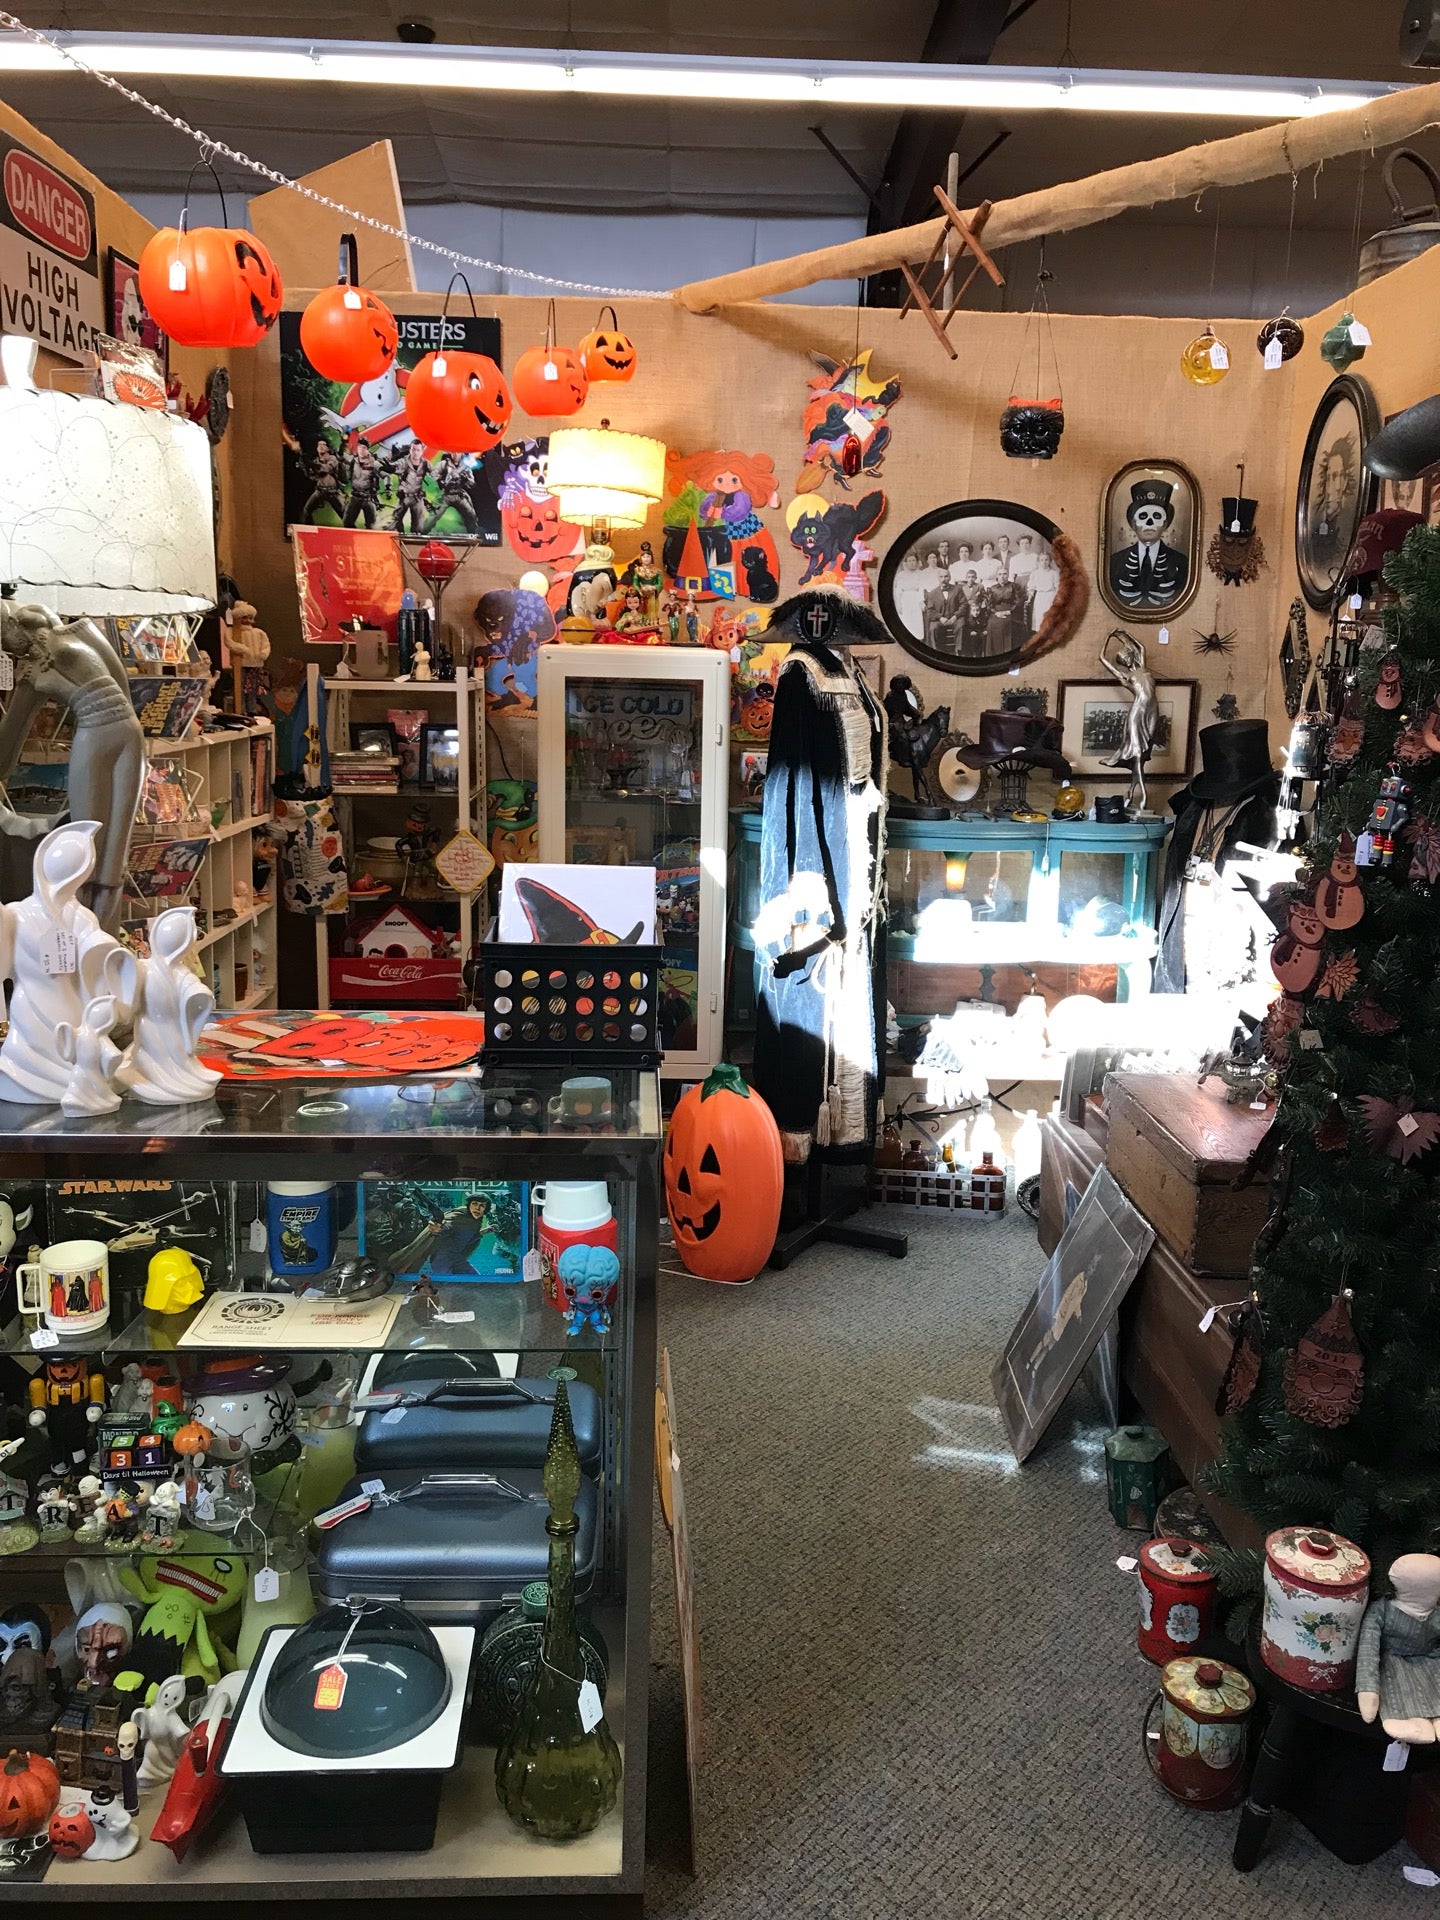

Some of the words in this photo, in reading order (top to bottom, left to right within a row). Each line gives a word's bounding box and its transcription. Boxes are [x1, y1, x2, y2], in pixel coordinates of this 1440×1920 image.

[10, 161, 88, 251] DANGER
[27, 251, 80, 313] HIGH
[396, 321, 467, 341] USTERS
[407, 341, 438, 350] GAME
[484, 532, 499, 541] Wii
[620, 695, 685, 716] COLD
[58, 1179, 117, 1196] STAR
[115, 1179, 172, 1193] WARS
[282, 1210, 318, 1218] EMPIRE
[1314, 1349, 1346, 1364] 2017
[116, 1453, 127, 1467] 3
[144, 1451, 156, 1465] 1
[103, 1471, 121, 1480] Days
[132, 1469, 169, 1477] Halloween
[322, 1673, 343, 1684] SALE
